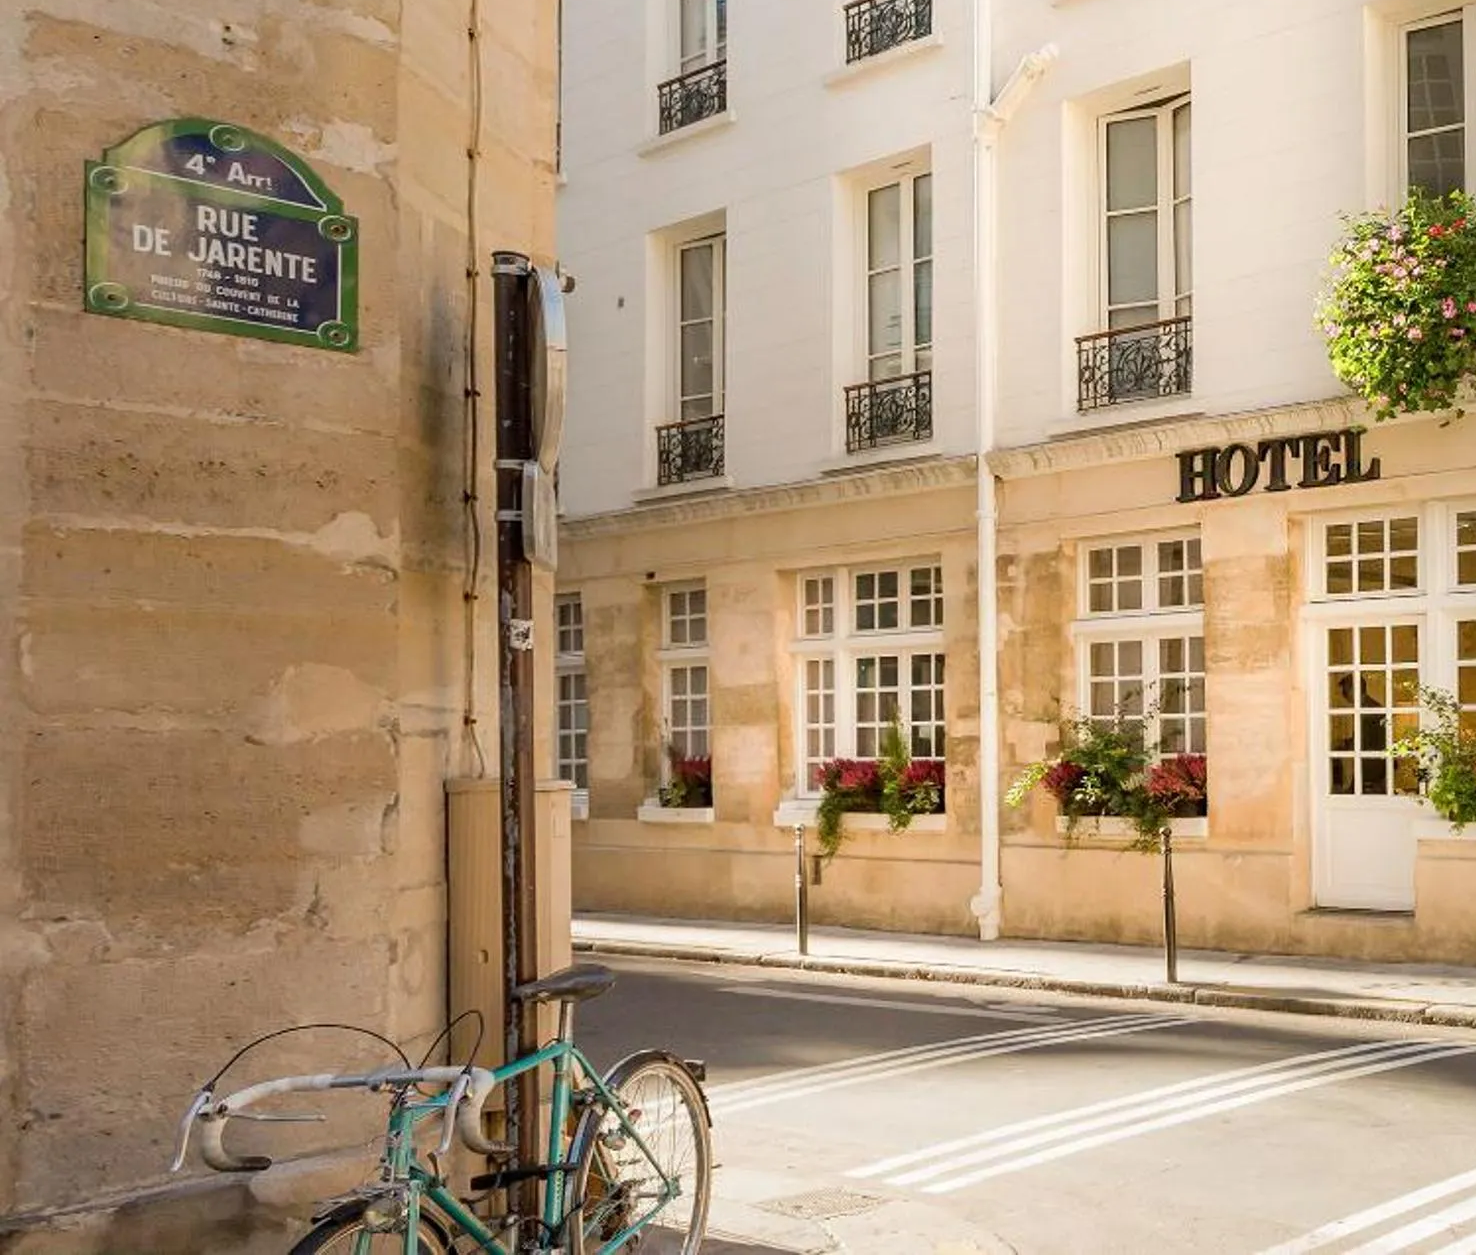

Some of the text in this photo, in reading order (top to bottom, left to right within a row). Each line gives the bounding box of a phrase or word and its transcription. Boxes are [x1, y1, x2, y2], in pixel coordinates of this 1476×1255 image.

[196, 205, 259, 242] RUE
[132, 224, 318, 283] DE JARENTE
[287, 297, 300, 309] LA
[1174, 428, 1381, 504] HOTEL
